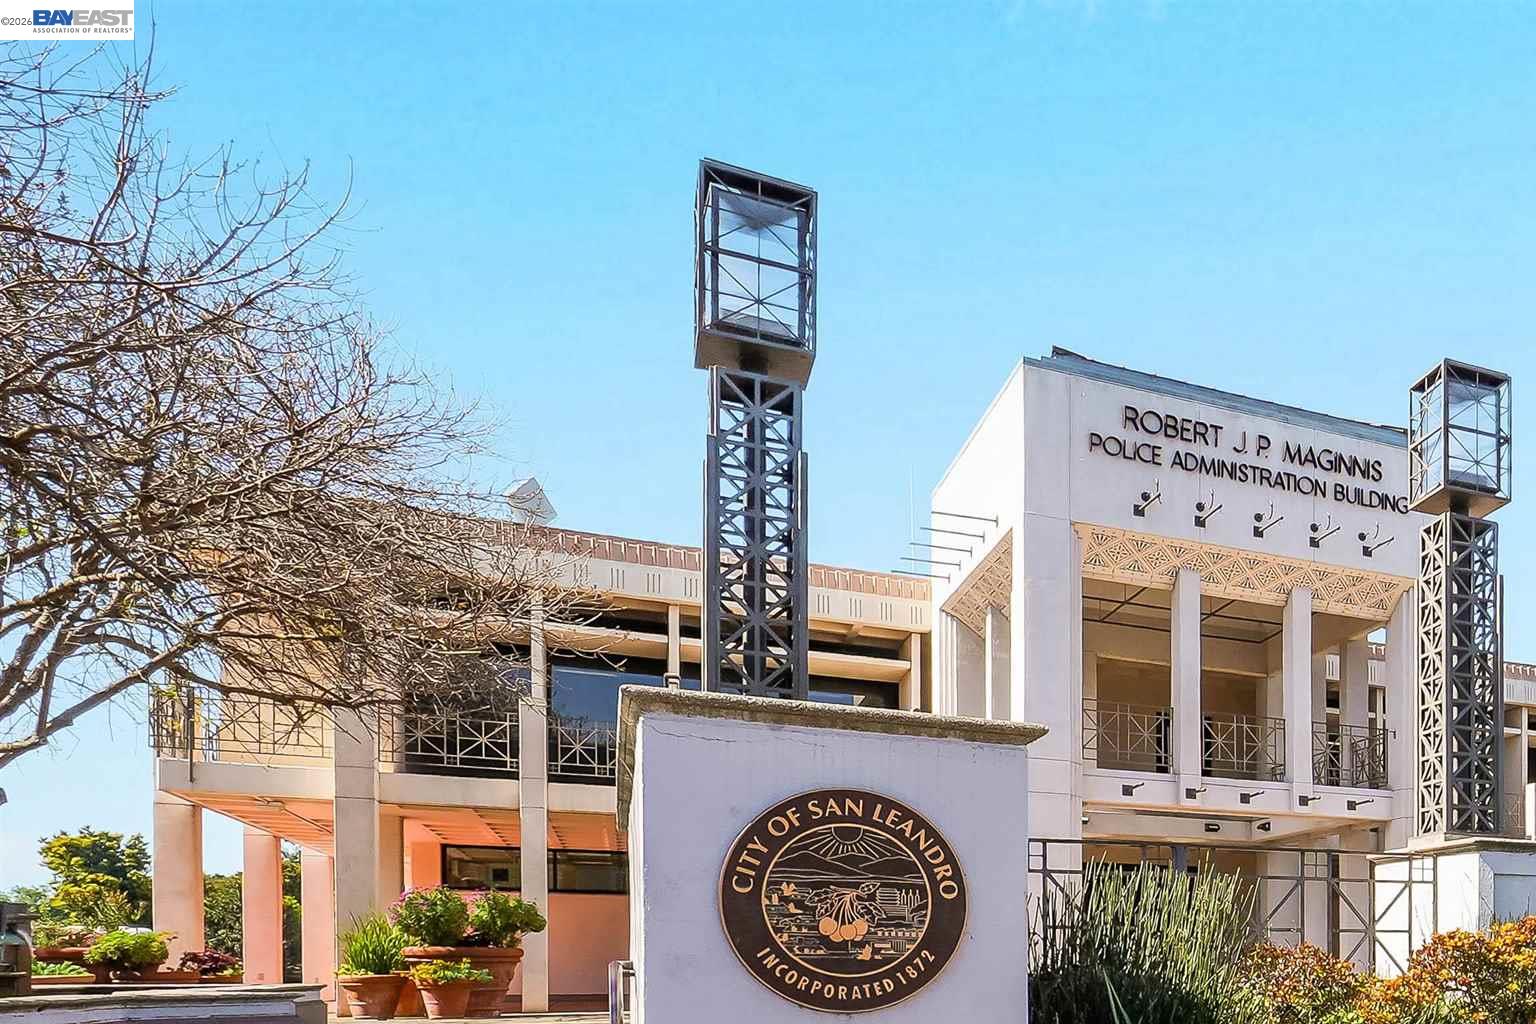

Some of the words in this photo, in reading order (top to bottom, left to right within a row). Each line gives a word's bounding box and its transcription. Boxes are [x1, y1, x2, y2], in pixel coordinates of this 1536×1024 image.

[1089, 432, 1162, 467] POLICE
[1170, 450, 1327, 498] ADMINISTRATION
[1333, 483, 1409, 515] BUILDING
[1122, 405, 1223, 448] ROBERT
[1282, 440, 1383, 482] MAGINNIS
[732, 836, 769, 894] CITY
[767, 807, 801, 838] OF
[807, 798, 863, 820] SAN
[872, 803, 959, 900] LEANDRO
[756, 947, 894, 1000] INCORPORATED
[896, 949, 936, 985] 1872
